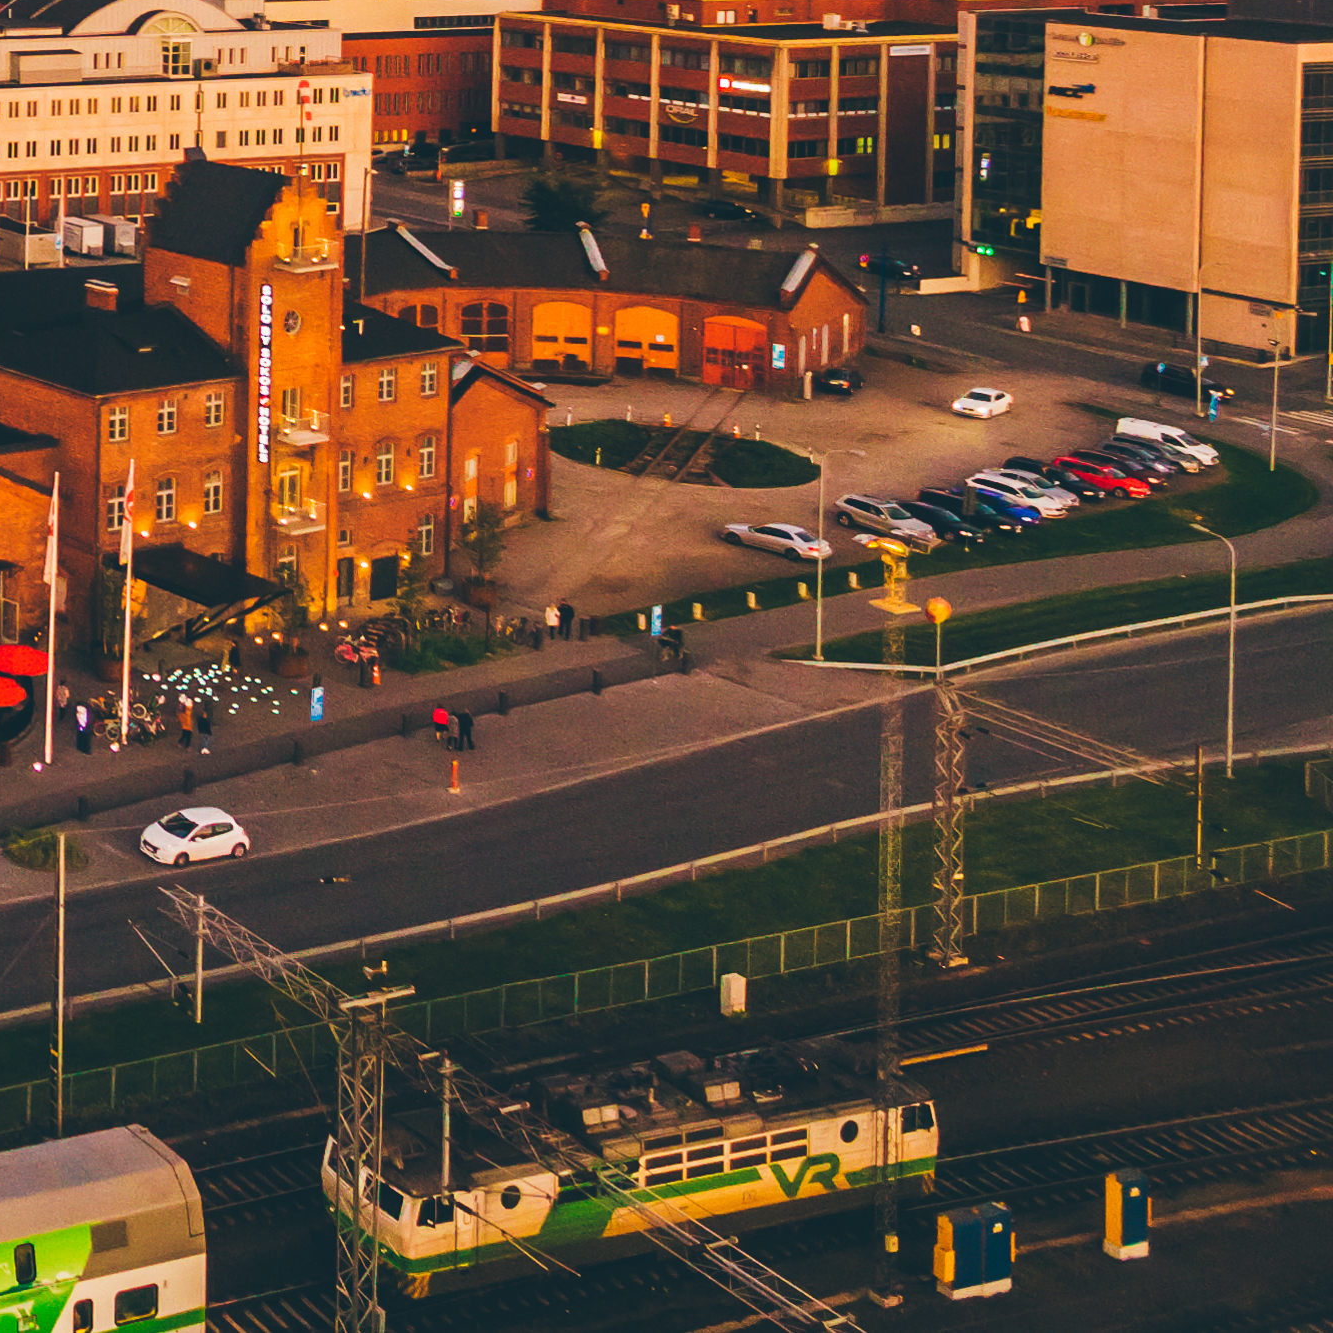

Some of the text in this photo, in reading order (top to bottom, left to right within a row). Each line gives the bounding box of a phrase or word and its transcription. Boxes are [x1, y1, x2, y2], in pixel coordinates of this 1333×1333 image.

[258, 284, 273, 463] SOLO BY SOKOS HOTELS
[769, 1152, 840, 1199] VR
